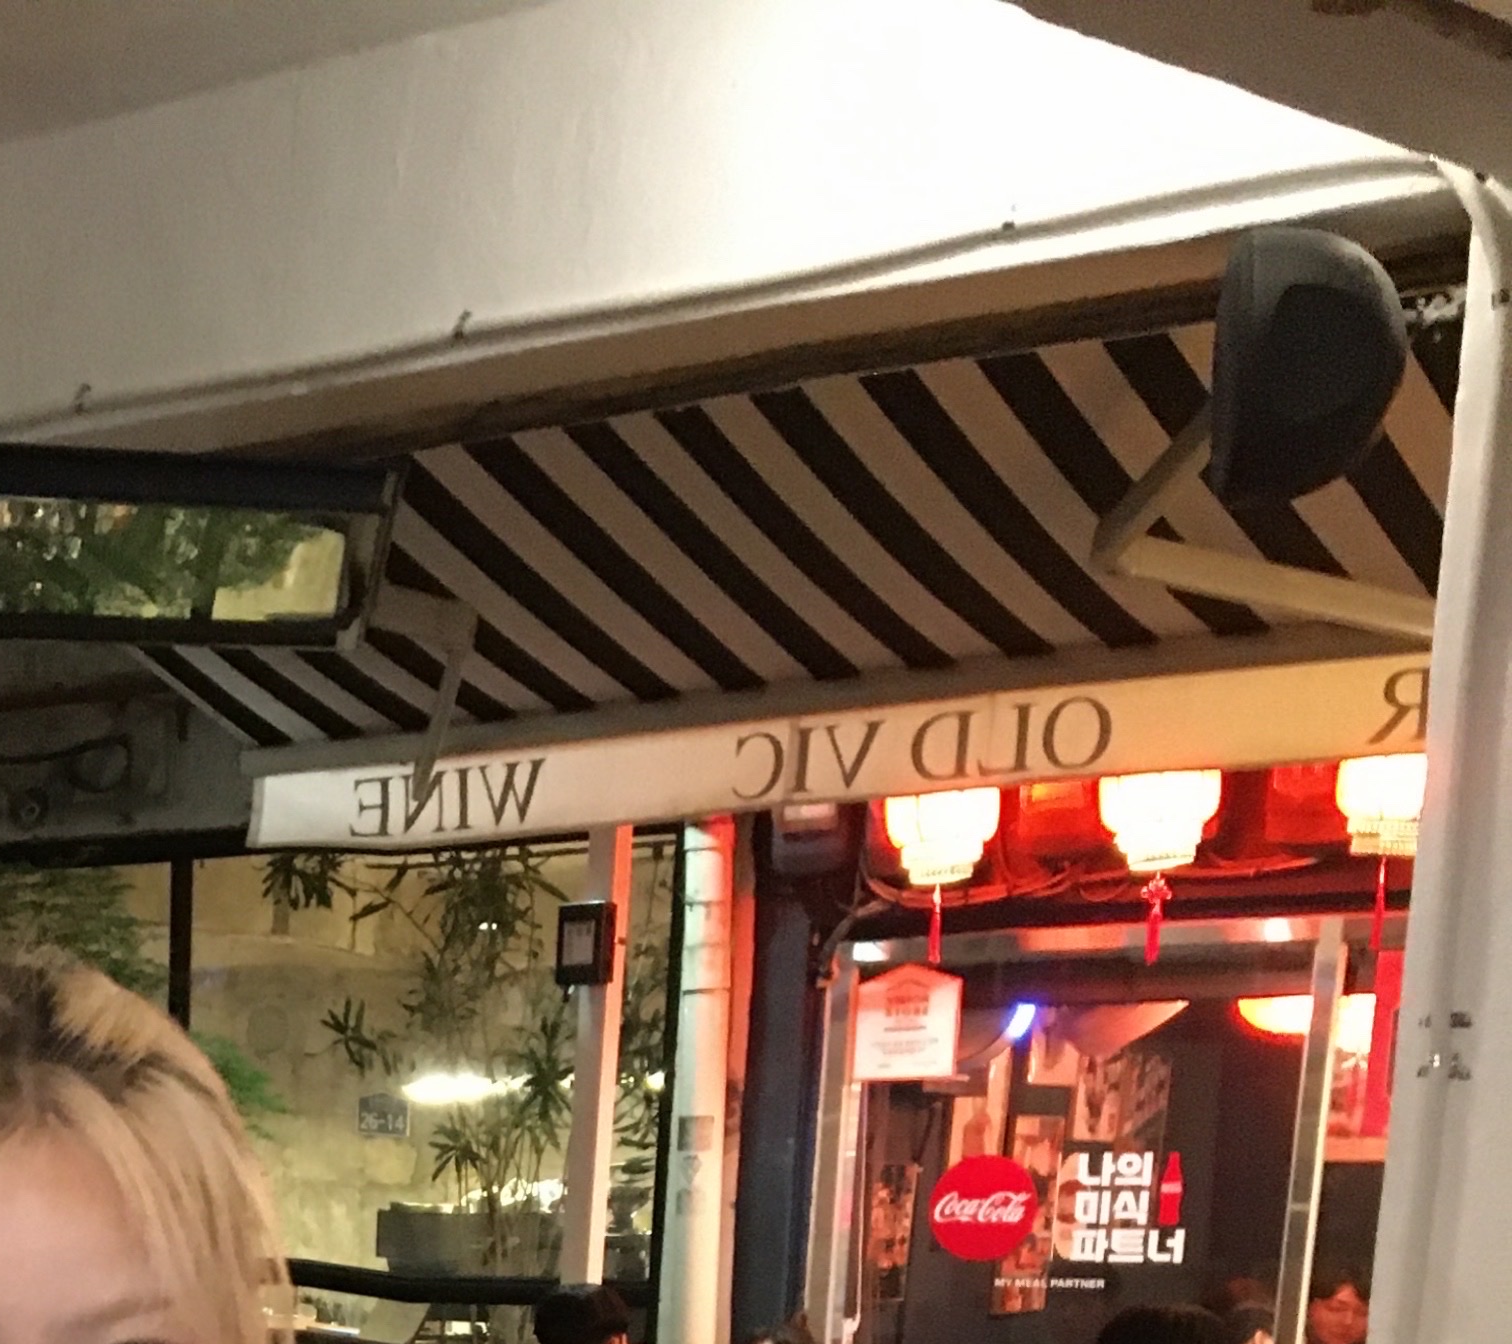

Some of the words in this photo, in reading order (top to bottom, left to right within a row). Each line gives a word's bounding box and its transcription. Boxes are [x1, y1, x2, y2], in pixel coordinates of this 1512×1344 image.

[360, 1112, 405, 1131] 26-14
[1076, 1150, 1155, 1188] 나의
[1074, 1189, 1150, 1226] 미식
[1069, 1227, 1186, 1265] 파트너
[994, 1278, 1012, 1288] MY
[1050, 1278, 1105, 1289] PARTNER
